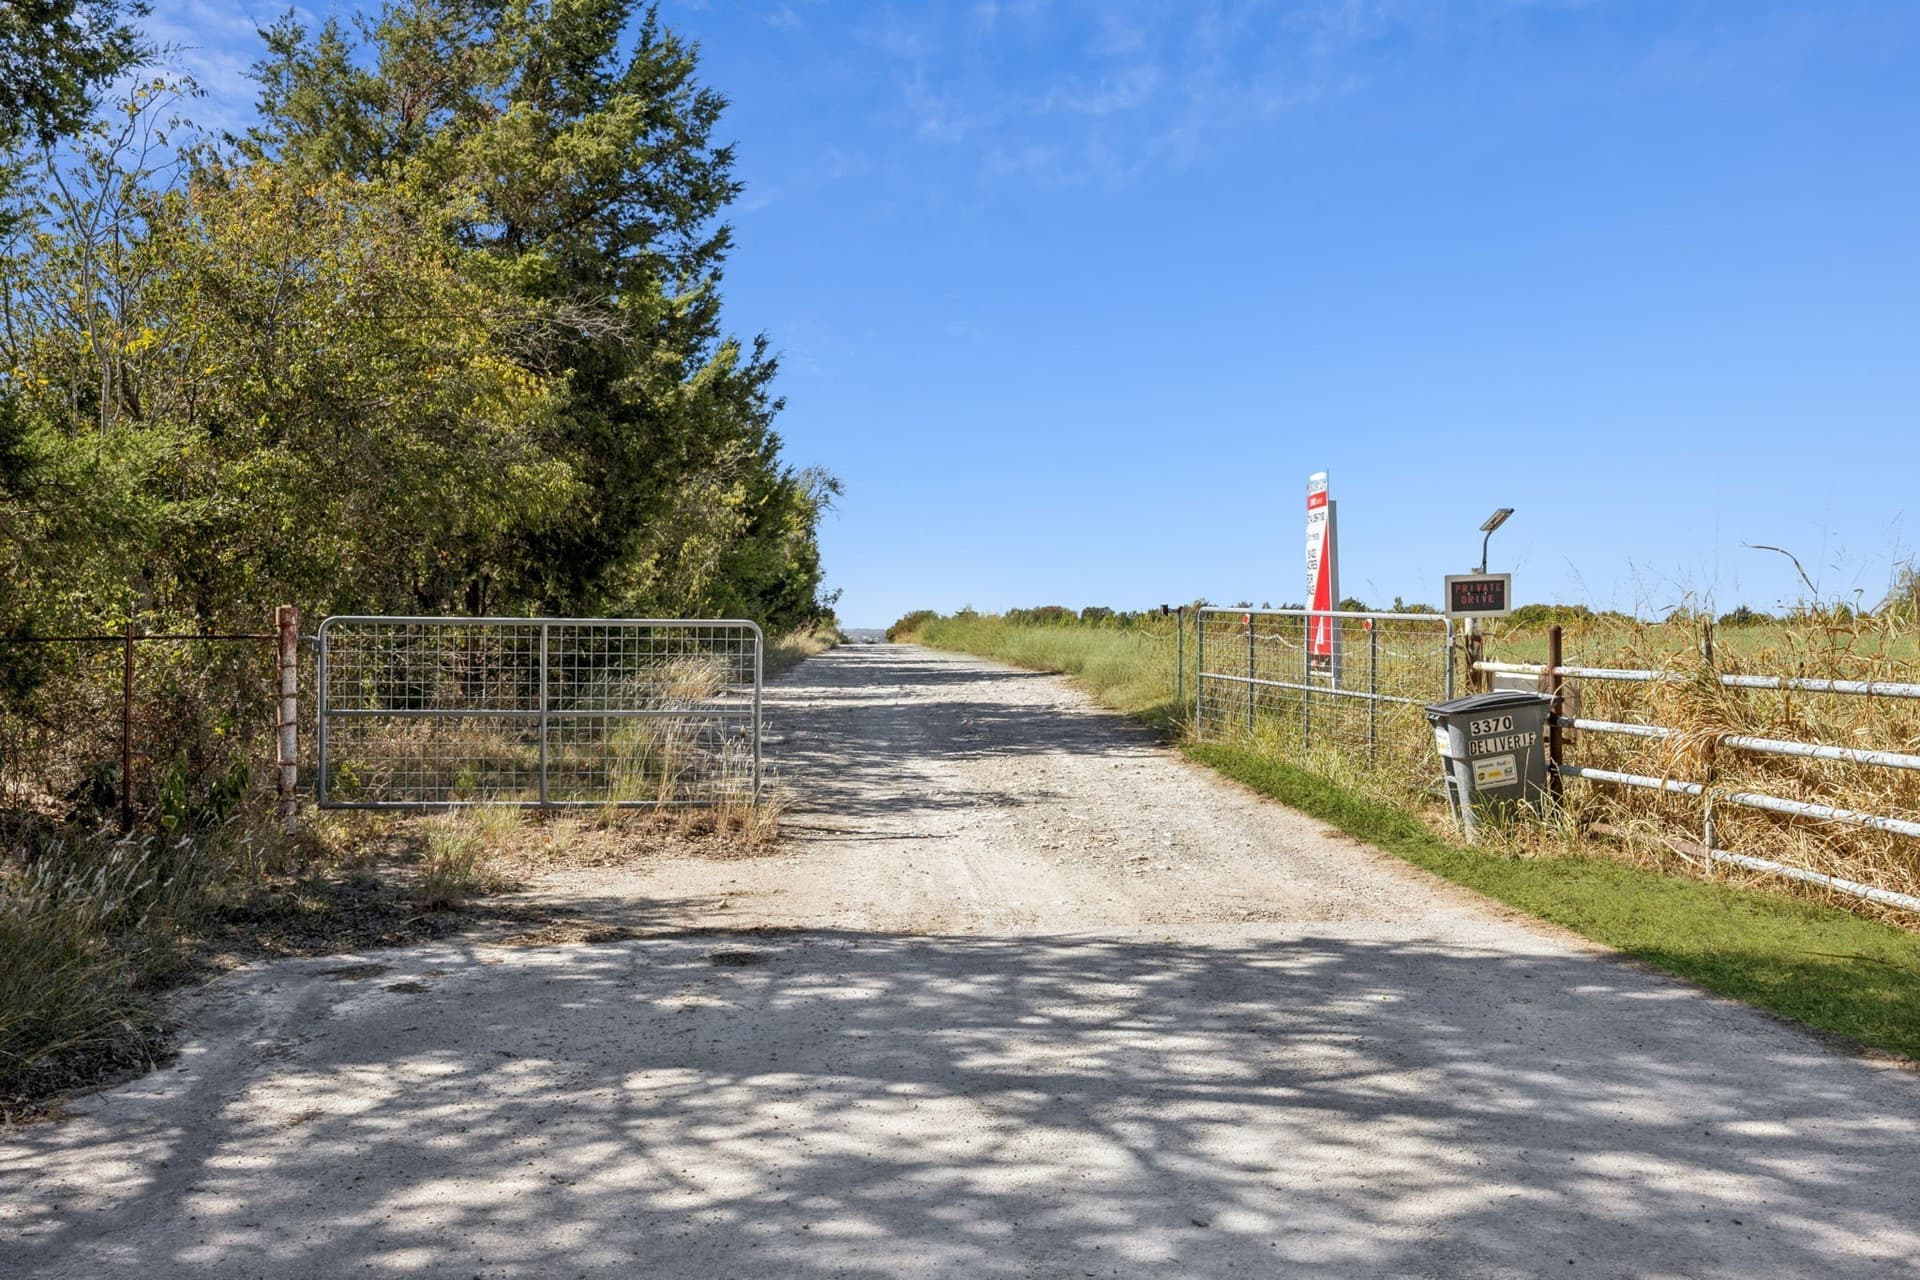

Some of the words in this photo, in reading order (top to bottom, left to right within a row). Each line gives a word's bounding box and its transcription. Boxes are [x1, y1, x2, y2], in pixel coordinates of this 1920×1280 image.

[1455, 583, 1502, 592] PRIVATE
[1461, 594, 1495, 604] DRIVE
[1471, 716, 1512, 735] 3370
